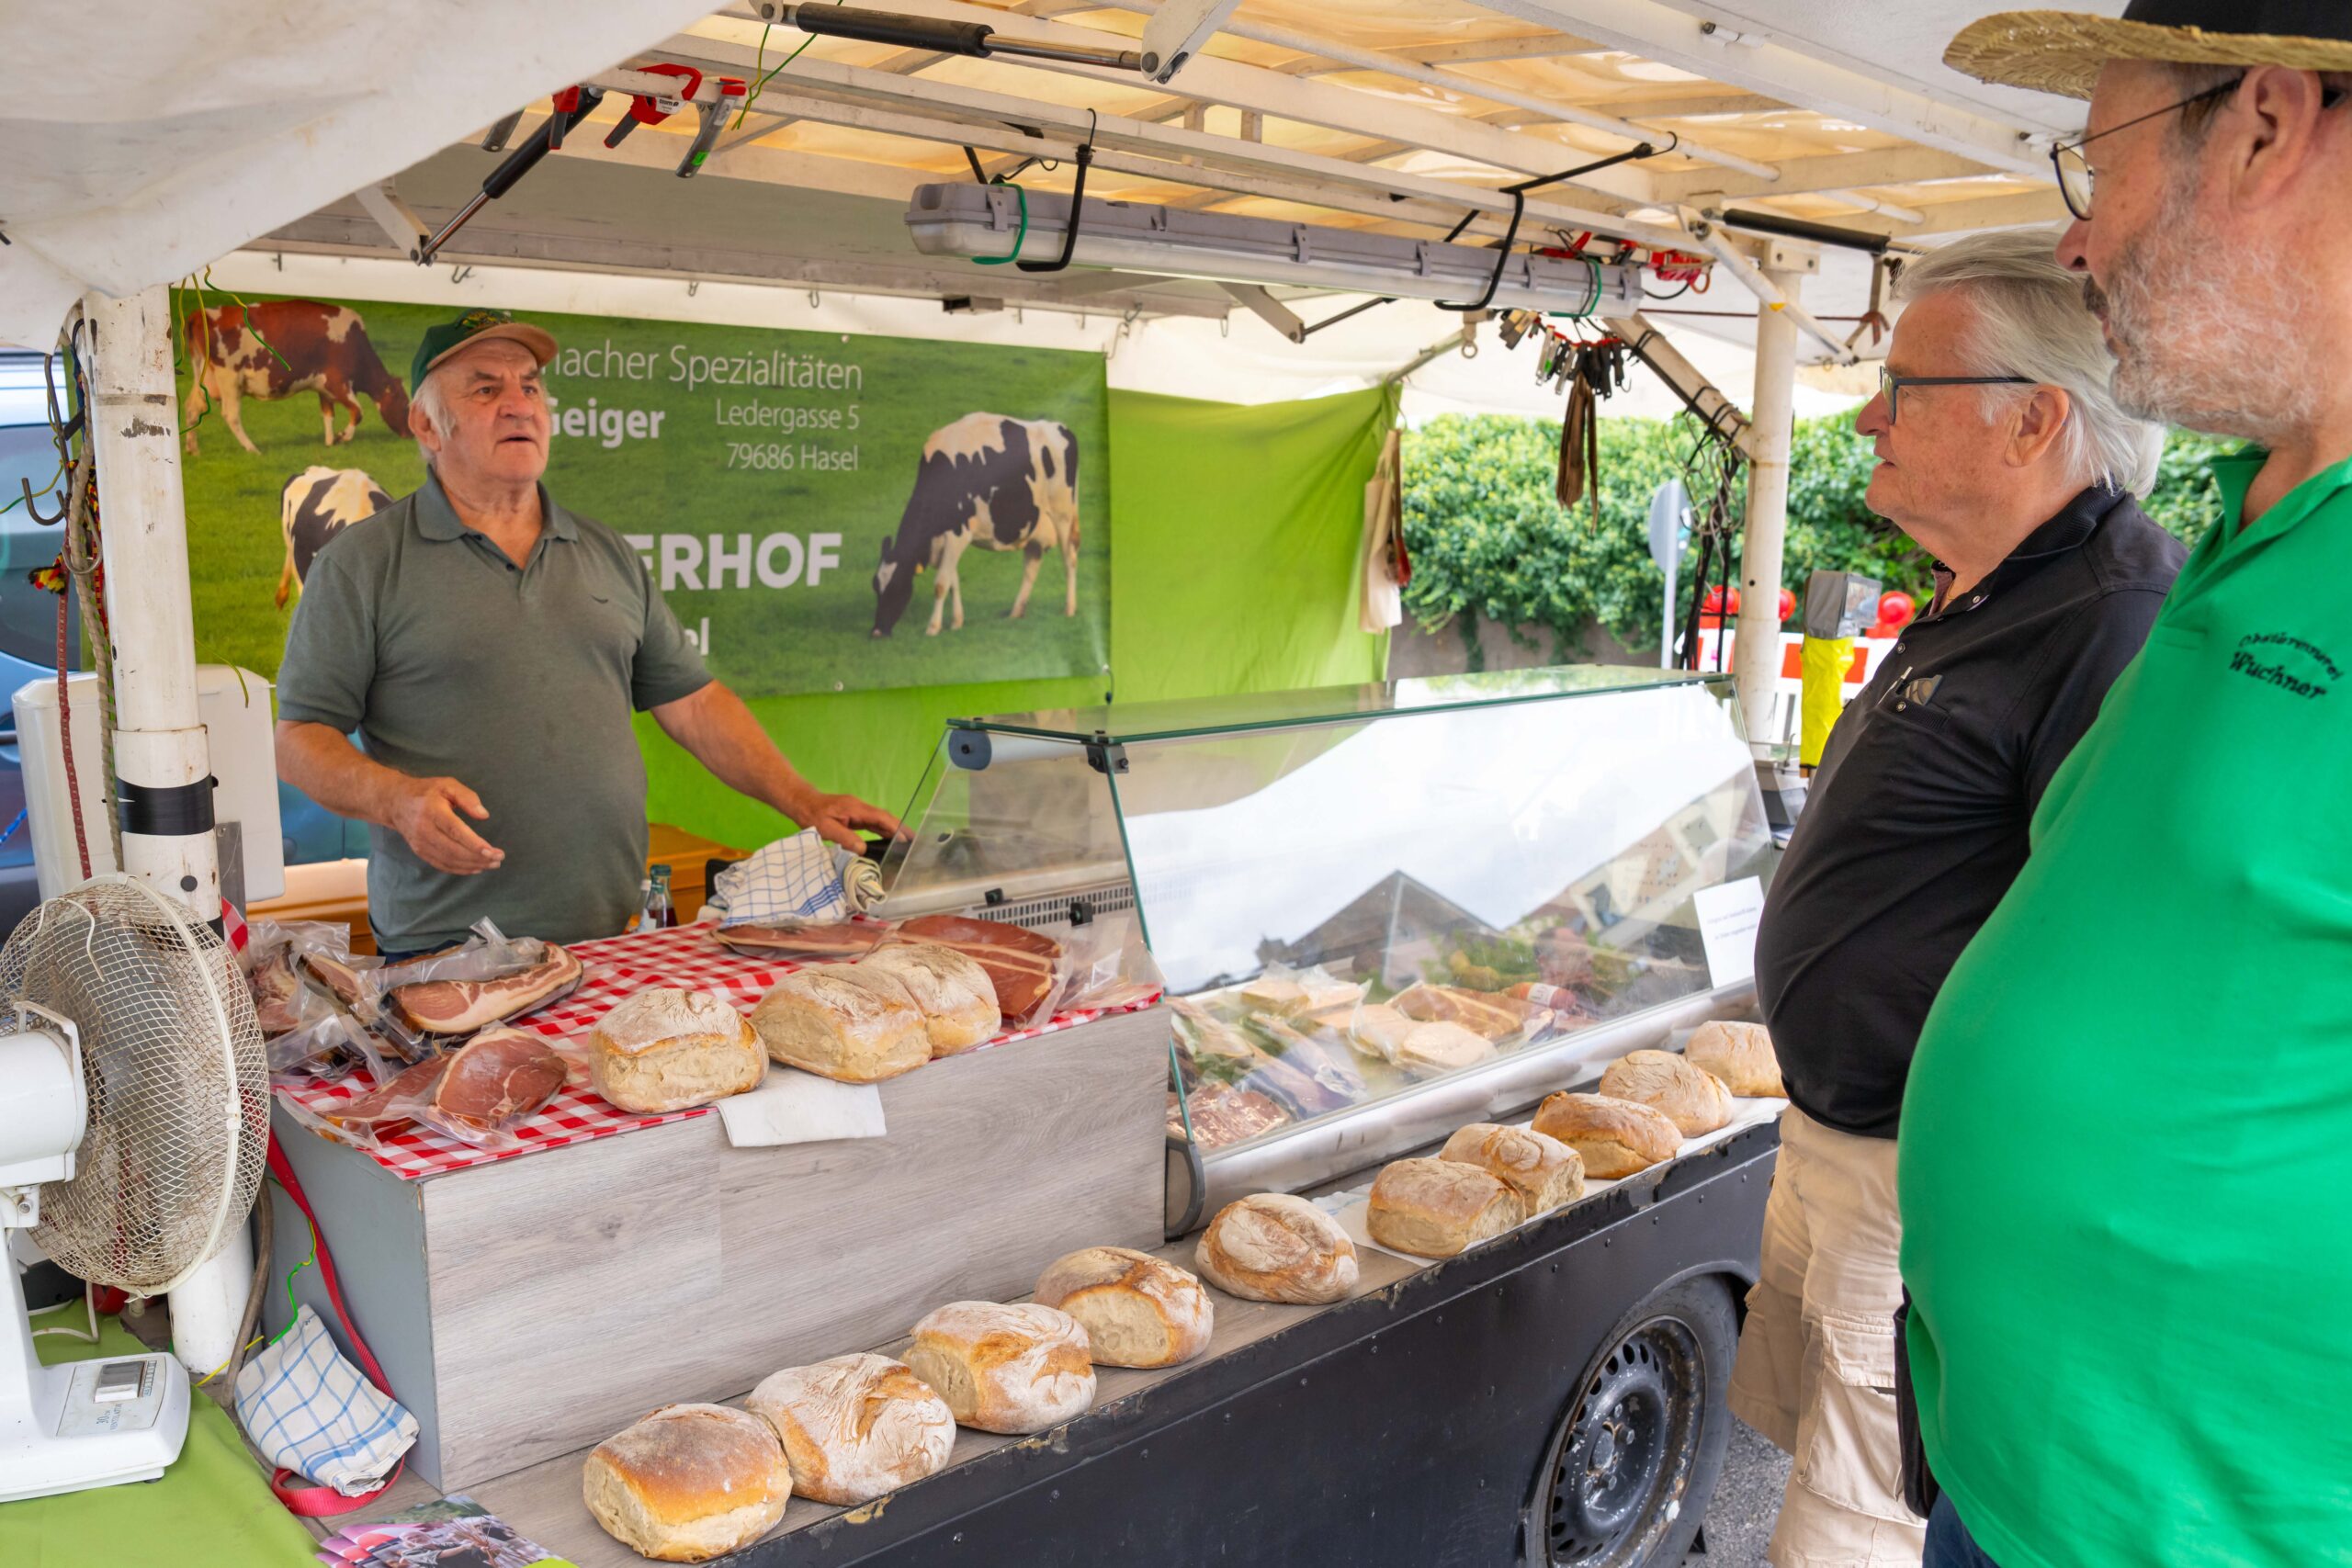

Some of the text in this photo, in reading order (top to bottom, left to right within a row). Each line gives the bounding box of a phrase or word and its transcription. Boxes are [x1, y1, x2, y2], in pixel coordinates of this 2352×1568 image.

[669, 344, 862, 392] Spezialitäten
[716, 398, 860, 434] Ledergasse 5
[726, 443, 858, 470] 79686 Hasel
[2228, 650, 2327, 699] Wuchner
